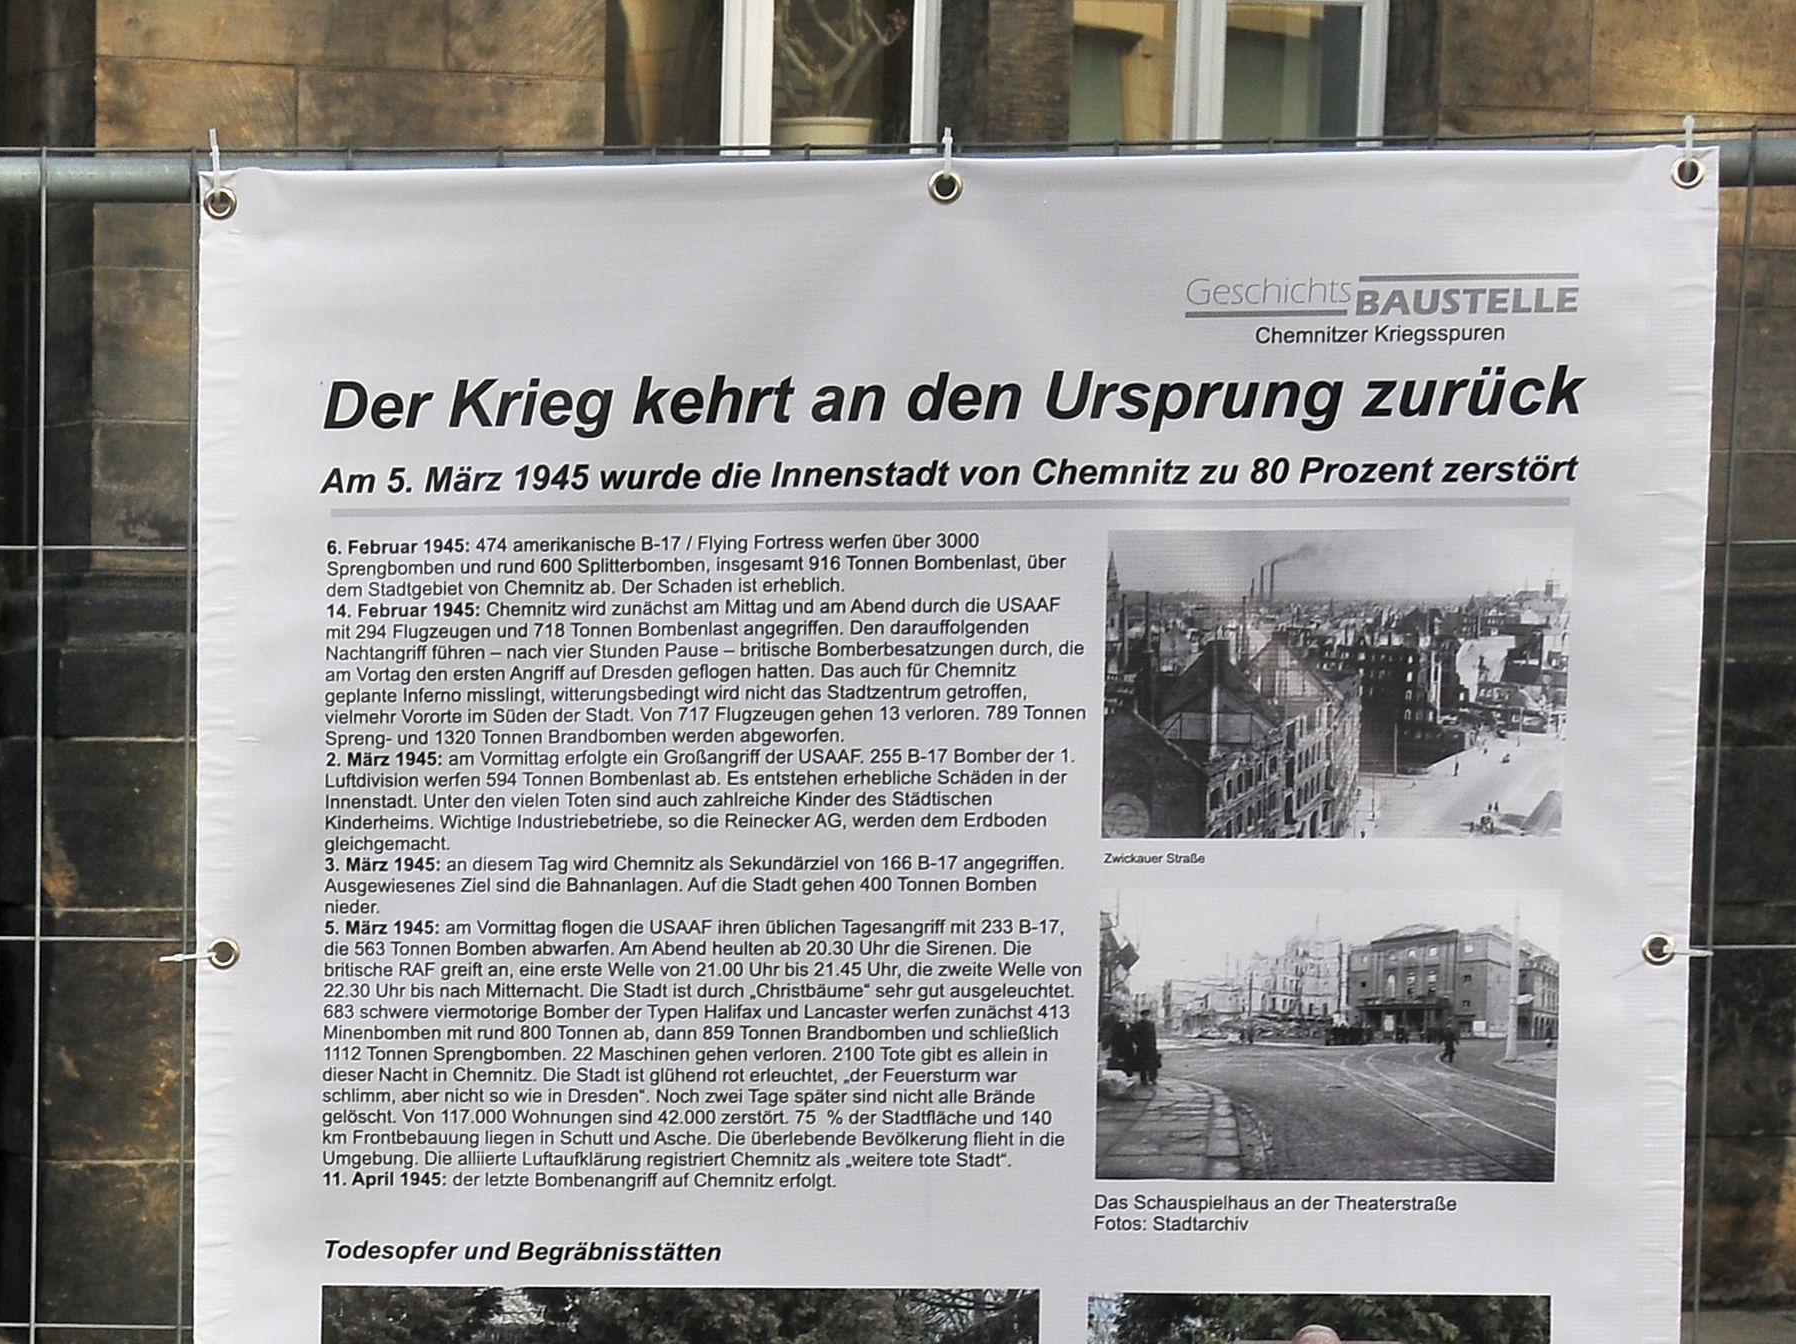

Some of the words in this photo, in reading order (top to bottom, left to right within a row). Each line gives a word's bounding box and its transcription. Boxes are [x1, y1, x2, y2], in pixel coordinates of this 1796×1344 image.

[1185, 277, 1352, 306] Geschichts
[1355, 286, 1580, 316] BAUSTELLE
[1255, 325, 1368, 344] Chemnitzer
[1374, 324, 1504, 346] Kriegsspuren
[320, 380, 434, 429] Der
[448, 377, 613, 438] Krieg
[632, 374, 795, 424] kehrt
[811, 384, 885, 422] an
[907, 371, 1021, 421] den
[1046, 370, 1343, 432] Ursprung
[1360, 364, 1587, 417] zurück
[319, 467, 375, 493] Am
[387, 467, 411, 493] 5.
[424, 465, 502, 492] März
[515, 463, 589, 490] 1945
[600, 462, 700, 489] wurde
[711, 461, 760, 488] die
[770, 459, 950, 487] Innenstadt
[959, 465, 1020, 486] von
[1032, 457, 1190, 485] Chemnitz
[1198, 464, 1238, 484] zu
[1250, 457, 1289, 484] 80
[1299, 456, 1434, 483] Prozent
[1440, 454, 1579, 482] zerstört
[1103, 852, 1163, 863] Zwickauer
[1166, 852, 1205, 863] Straße
[322, 1171, 346, 1186] 11.
[351, 1170, 393, 1189] April
[400, 1171, 446, 1186] 1945:
[452, 1171, 480, 1186] der
[485, 1171, 529, 1186] letzte
[535, 1172, 658, 1191] Bombenangriff
[662, 1172, 689, 1187] auf
[693, 1172, 774, 1187] Chemnitz
[779, 1172, 836, 1191] erfolgt.
[1094, 1194, 1128, 1209] Das
[1133, 1194, 1269, 1213] Schauspielhaus
[1274, 1198, 1295, 1210] an
[1301, 1194, 1330, 1210] der
[1334, 1195, 1456, 1211] Theaterstraße
[1094, 1215, 1146, 1231] Fotos:
[1152, 1215, 1248, 1231] Stadtarchiv
[324, 1239, 458, 1264] Todesopfer
[464, 1241, 510, 1260] und
[516, 1241, 721, 1265] Begräbnisstätten
